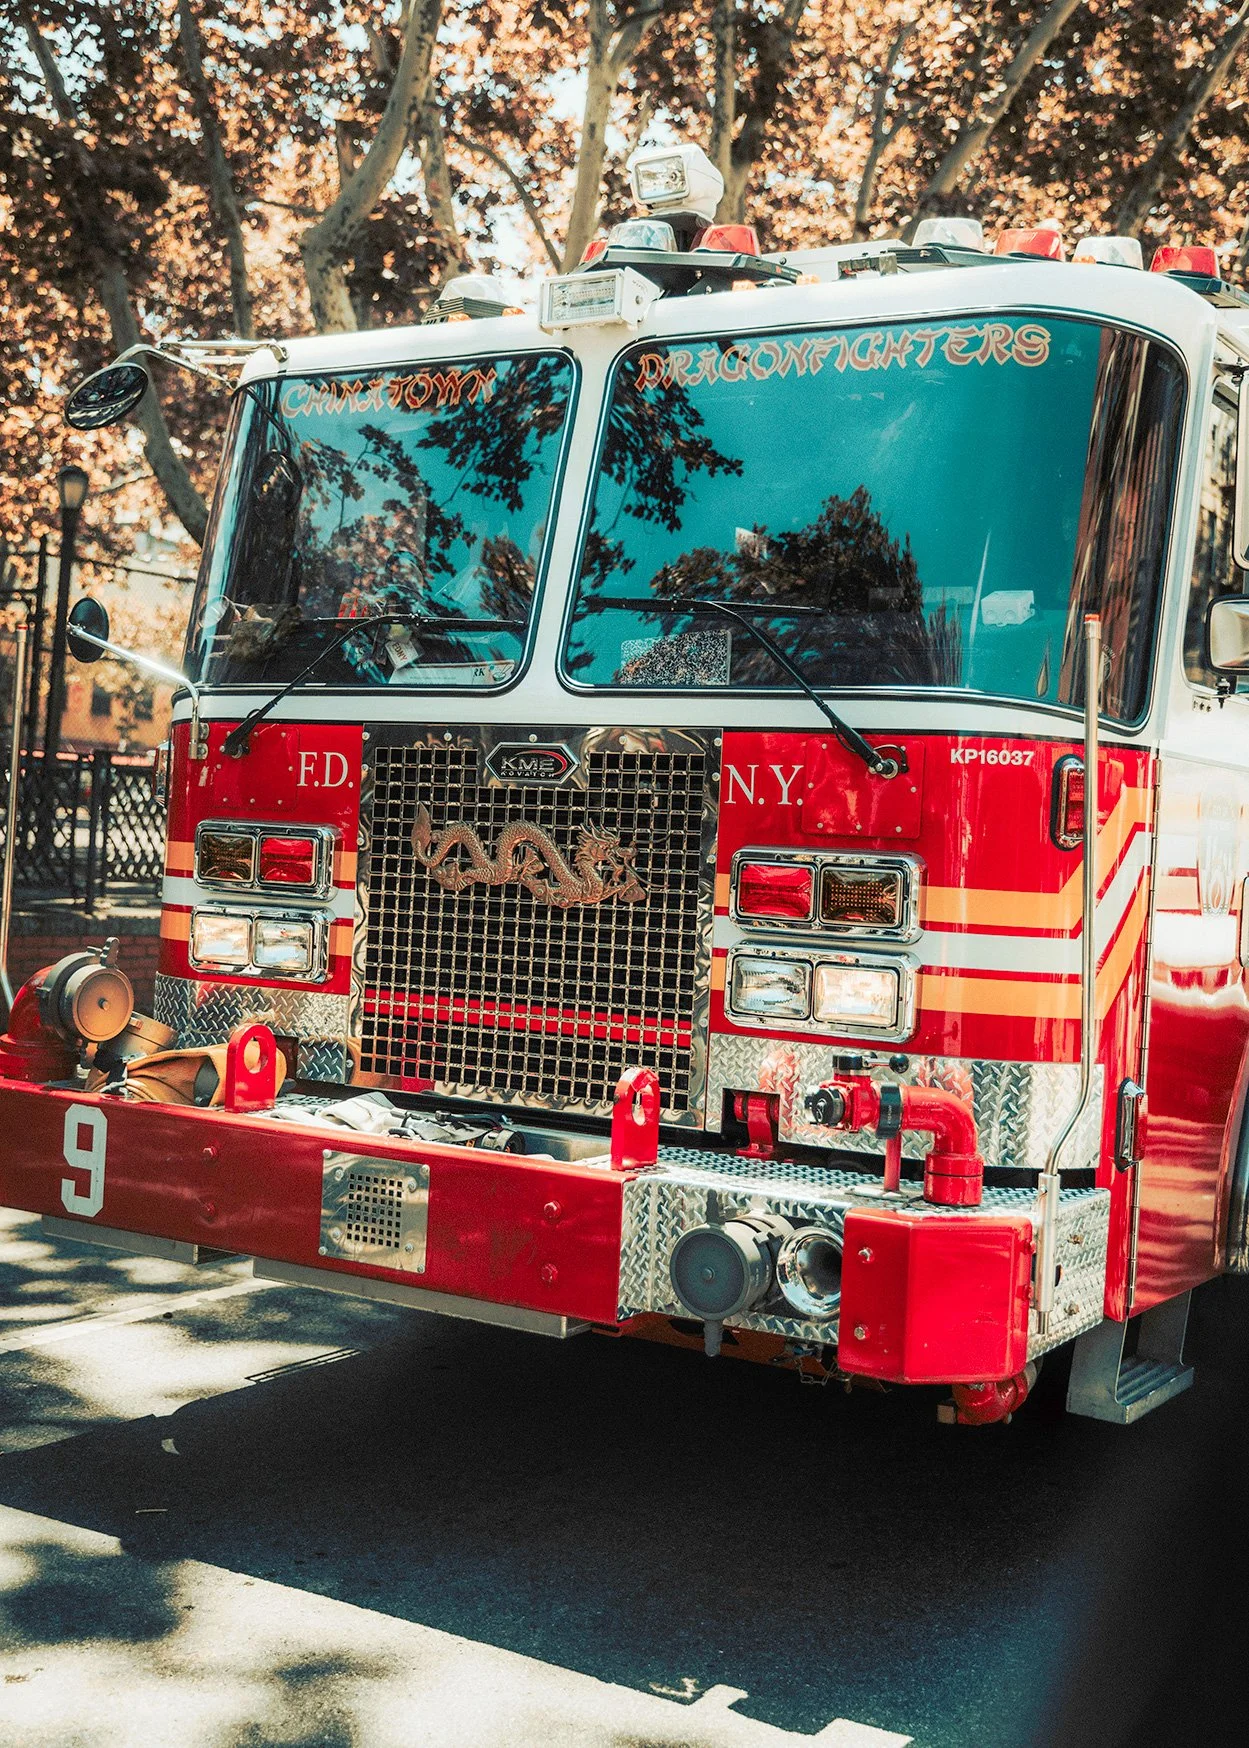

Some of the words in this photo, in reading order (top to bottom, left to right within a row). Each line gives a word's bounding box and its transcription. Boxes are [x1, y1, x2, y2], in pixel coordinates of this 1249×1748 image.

[281, 367, 498, 419] CHINATOWN
[634, 323, 1051, 393] DRAGONFIGHTERS
[296, 751, 354, 789] F.D.
[723, 764, 804, 806] N.Y.
[501, 756, 555, 771] KME
[950, 748, 1035, 767] KP16037
[61, 1103, 108, 1218] 9
